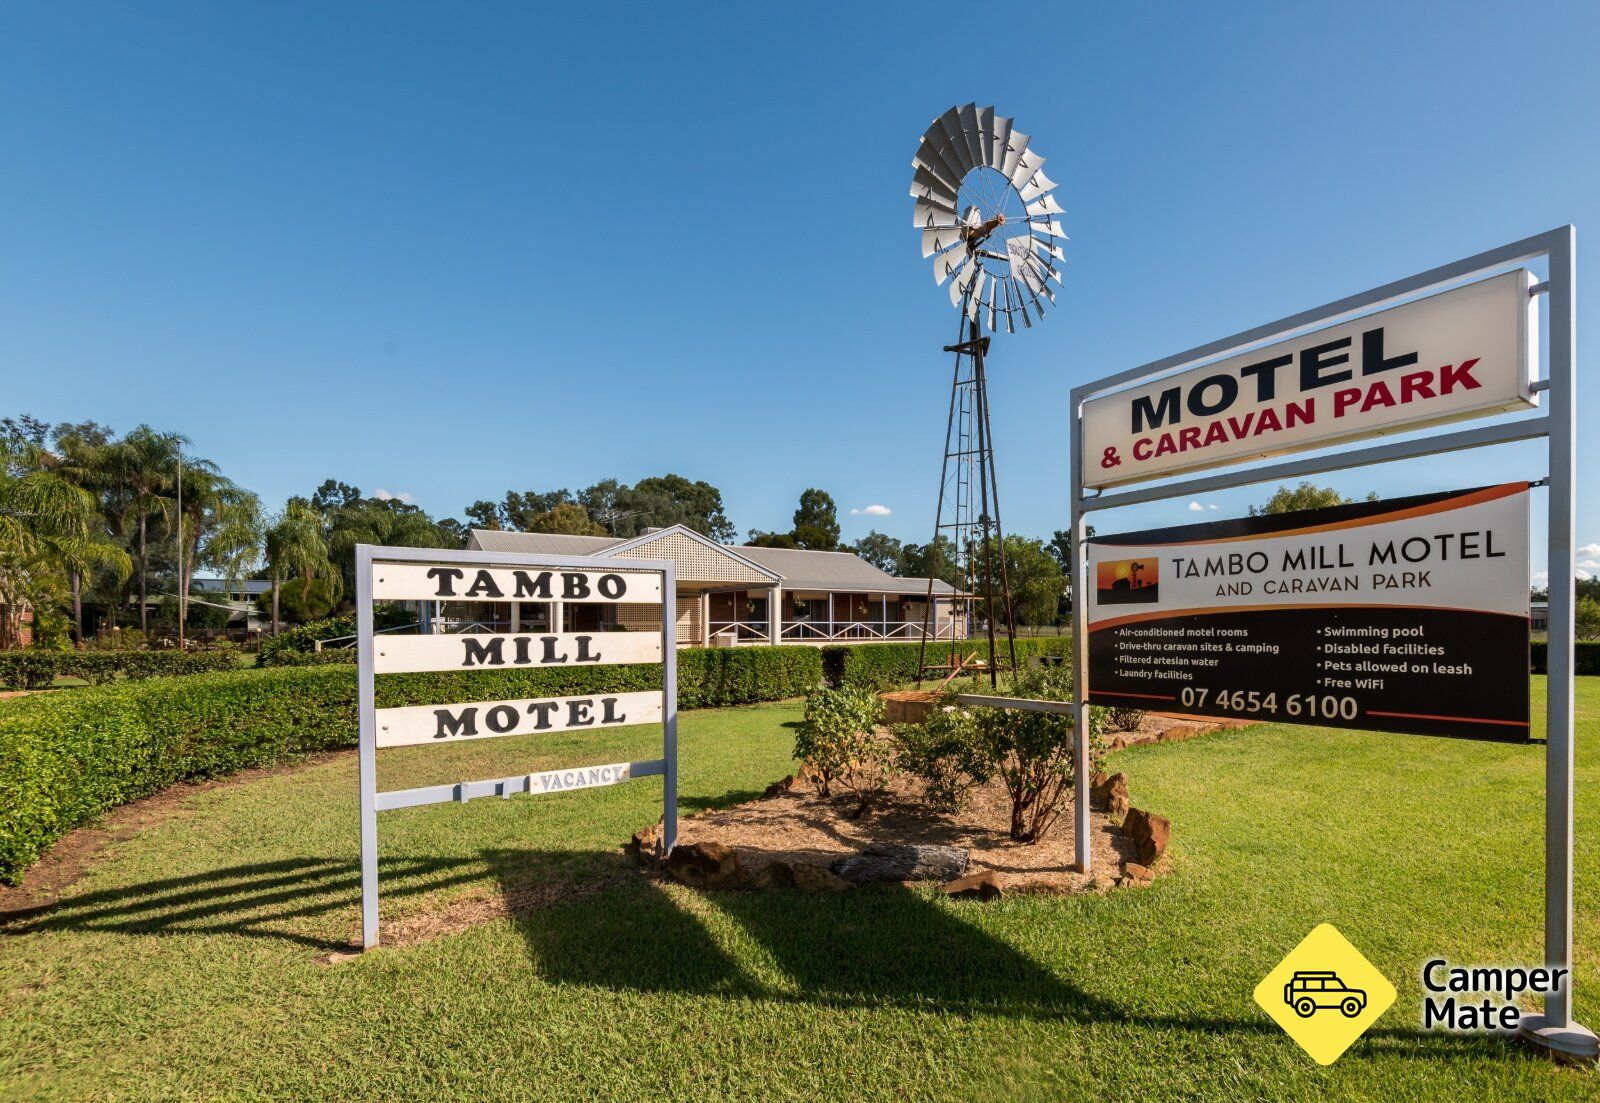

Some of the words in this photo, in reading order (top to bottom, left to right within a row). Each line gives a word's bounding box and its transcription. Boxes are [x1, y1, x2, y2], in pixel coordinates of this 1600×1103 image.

[1131, 327, 1418, 434] MOTEL
[1101, 446, 1121, 469] &
[1133, 398, 1315, 461] CARAVAN
[1334, 357, 1482, 418] PARK
[1172, 551, 1269, 579] TAMBO
[1282, 543, 1354, 572] MILL
[1368, 530, 1506, 566] MOTEL
[427, 567, 627, 600] TAMBO
[1215, 581, 1253, 597] AND
[1263, 575, 1359, 595] CARAVAN
[1372, 570, 1432, 590] PARK
[1119, 628, 1185, 637] Air-conditioned
[1186, 628, 1215, 637] motel
[1216, 629, 1248, 637] rooms
[1324, 626, 1389, 638] Swimming
[1392, 626, 1424, 638] pool
[461, 635, 601, 666] MILL
[1119, 642, 1161, 650] Drive-thru
[1163, 643, 1198, 651] caravan
[1200, 643, 1223, 652] sites
[1225, 643, 1234, 652] &
[1235, 643, 1280, 654] camping
[1119, 655, 1151, 664] Filtered
[1153, 657, 1189, 665] artesian
[1191, 658, 1219, 666] water
[1324, 643, 1379, 654] Disabled
[1383, 644, 1445, 655] facilities
[1119, 669, 1152, 679] Laundry
[1154, 670, 1193, 680] facilities
[1324, 660, 1352, 671] Pets
[1355, 661, 1407, 673] allowed
[1411, 665, 1429, 674] on
[1433, 663, 1473, 675] leash
[1324, 677, 1352, 688] Free
[1355, 679, 1384, 690] WiFi
[1181, 687, 1209, 707] 07
[1215, 689, 1278, 714] 4654
[1286, 694, 1358, 720] 6100
[433, 697, 626, 739] MOTEL
[540, 766, 623, 791] VACANCY
